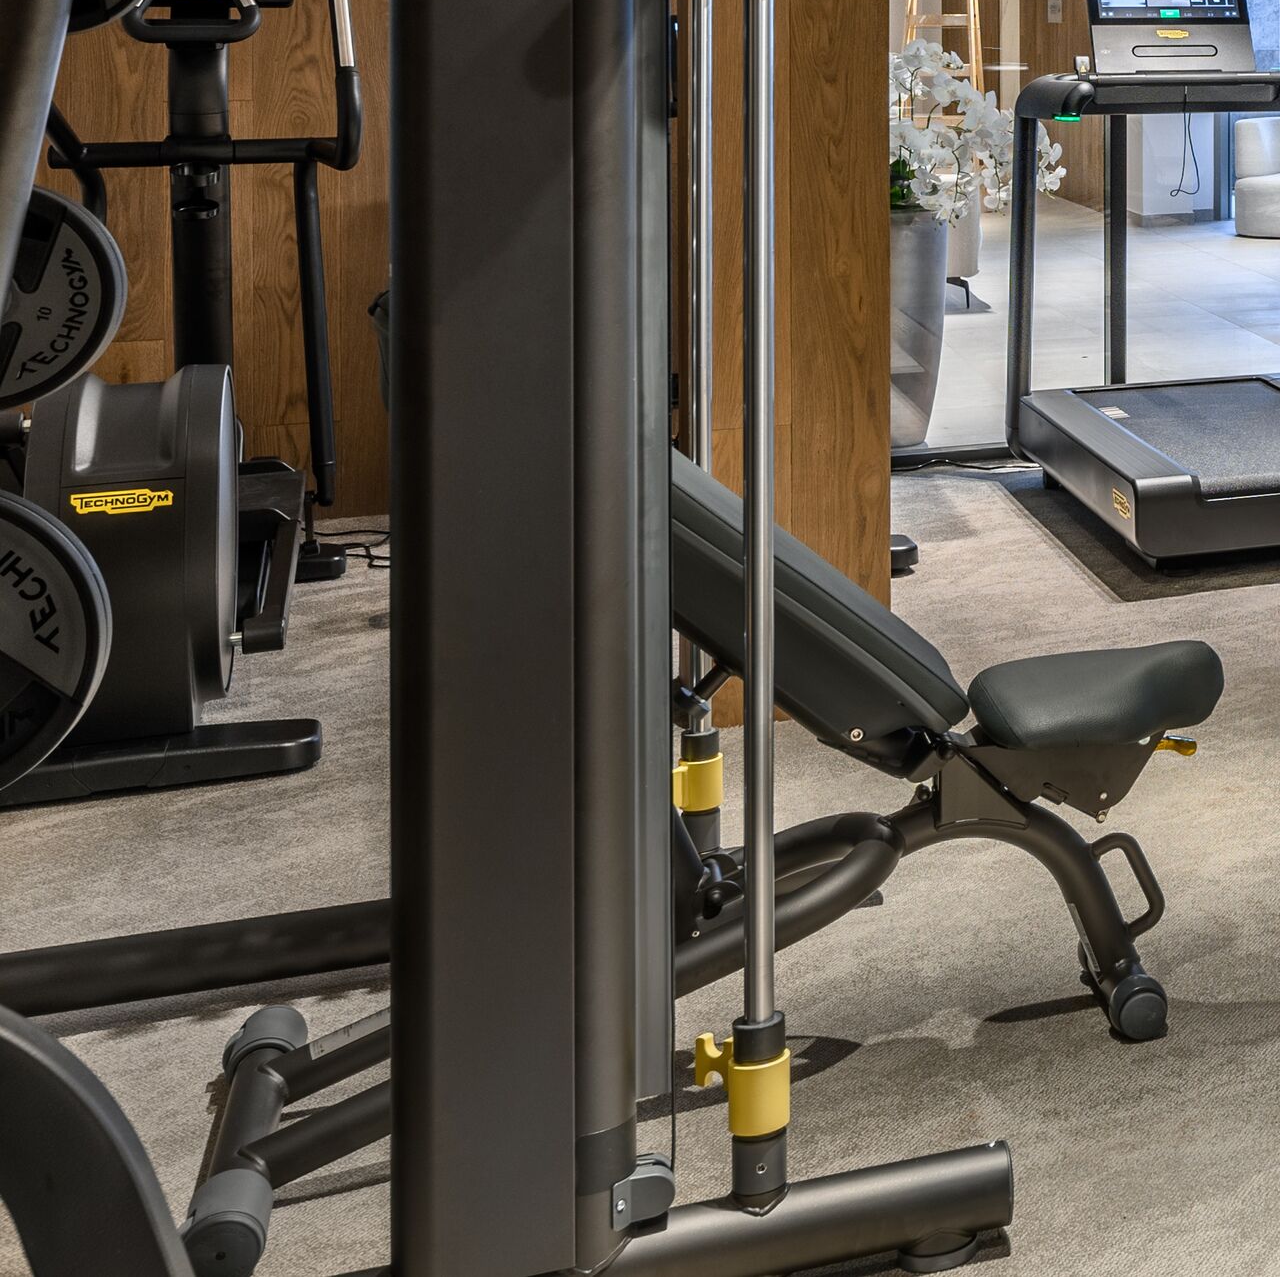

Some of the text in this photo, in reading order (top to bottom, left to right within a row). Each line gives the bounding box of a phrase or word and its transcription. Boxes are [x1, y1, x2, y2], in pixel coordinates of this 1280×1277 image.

[16, 248, 90, 380] TECHNOGYM
[36, 306, 53, 321] 10
[72, 491, 170, 511] TECHNOGYM
